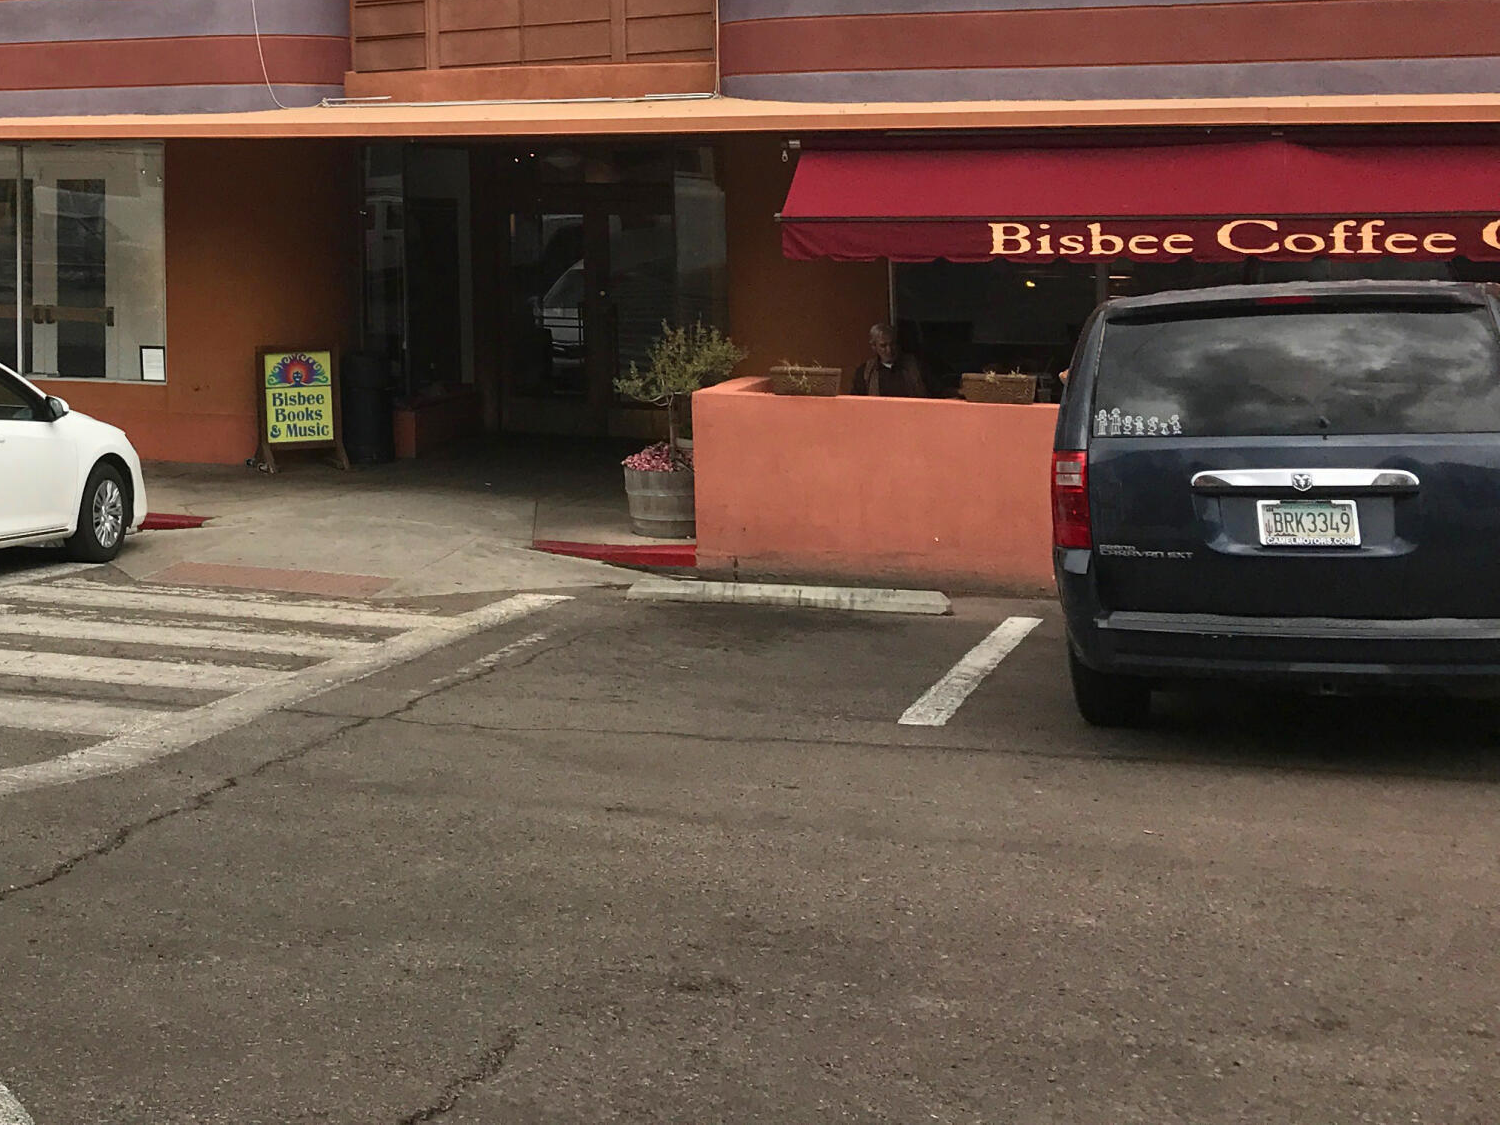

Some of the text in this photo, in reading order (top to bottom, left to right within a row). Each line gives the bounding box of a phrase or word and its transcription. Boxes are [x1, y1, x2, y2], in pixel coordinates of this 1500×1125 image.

[988, 222, 1194, 255] Bisbee
[1216, 219, 1457, 255] Coffee
[272, 392, 325, 407] Bisbee
[275, 407, 323, 423] Books
[270, 422, 330, 439] & Music
[1273, 512, 1350, 533] BRK3349
